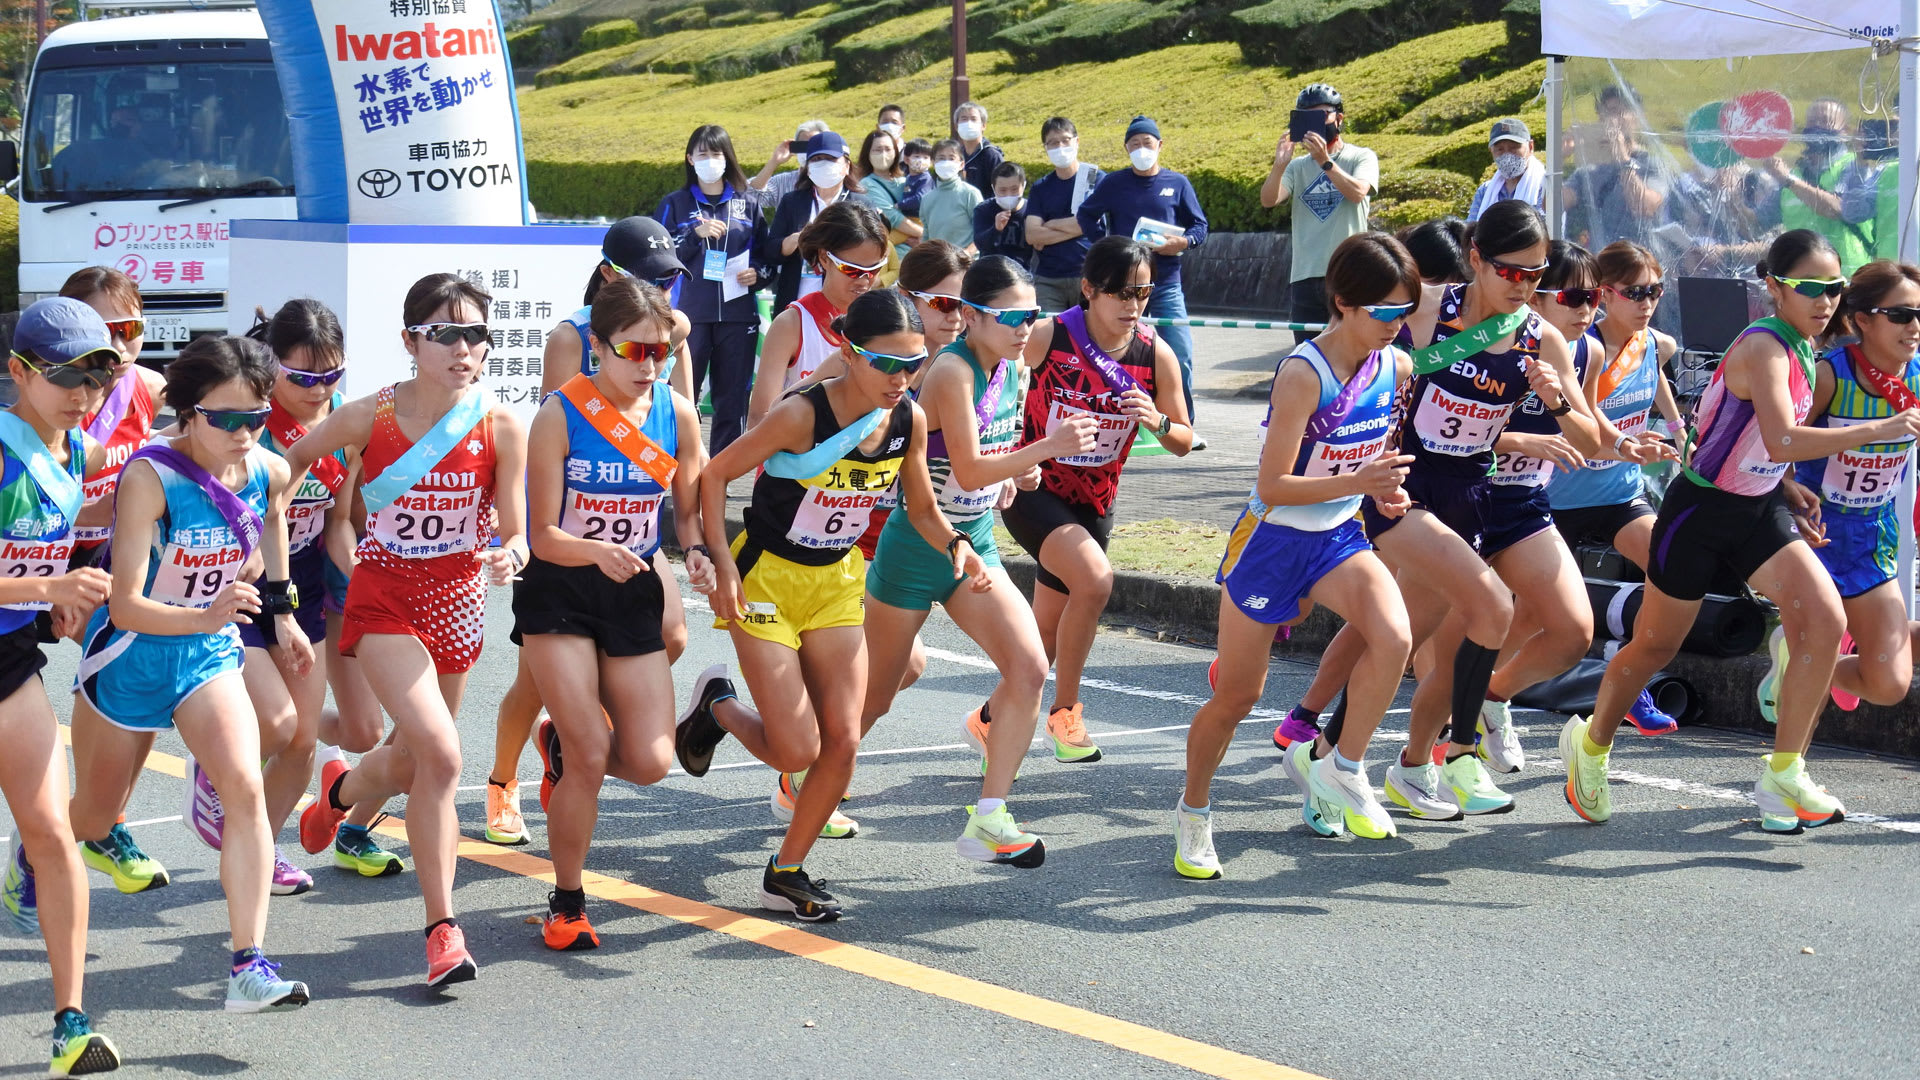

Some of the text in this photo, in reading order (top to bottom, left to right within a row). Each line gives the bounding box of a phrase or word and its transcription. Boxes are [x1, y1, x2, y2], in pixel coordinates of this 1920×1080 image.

[335, 18, 497, 62] Iwatani
[354, 62, 432, 103] 水素で
[408, 138, 488, 162] 車両協力
[406, 163, 513, 192] TOYOTA
[117, 222, 229, 242] プリンセス駅伝
[126, 242, 176, 250] PRINCESS
[493, 300, 552, 320] 福津市
[152, 326, 187, 340] 12-12
[1869, 368, 1917, 409] シスメ
[1430, 388, 1510, 421] Iwatani
[826, 467, 891, 492] 九電工
[1844, 470, 1899, 494] 15-1
[574, 493, 662, 515] Iwatani
[11, 513, 67, 538] 宮崎銀
[394, 512, 467, 541] 20-1
[743, 613, 778, 625] 九電工
